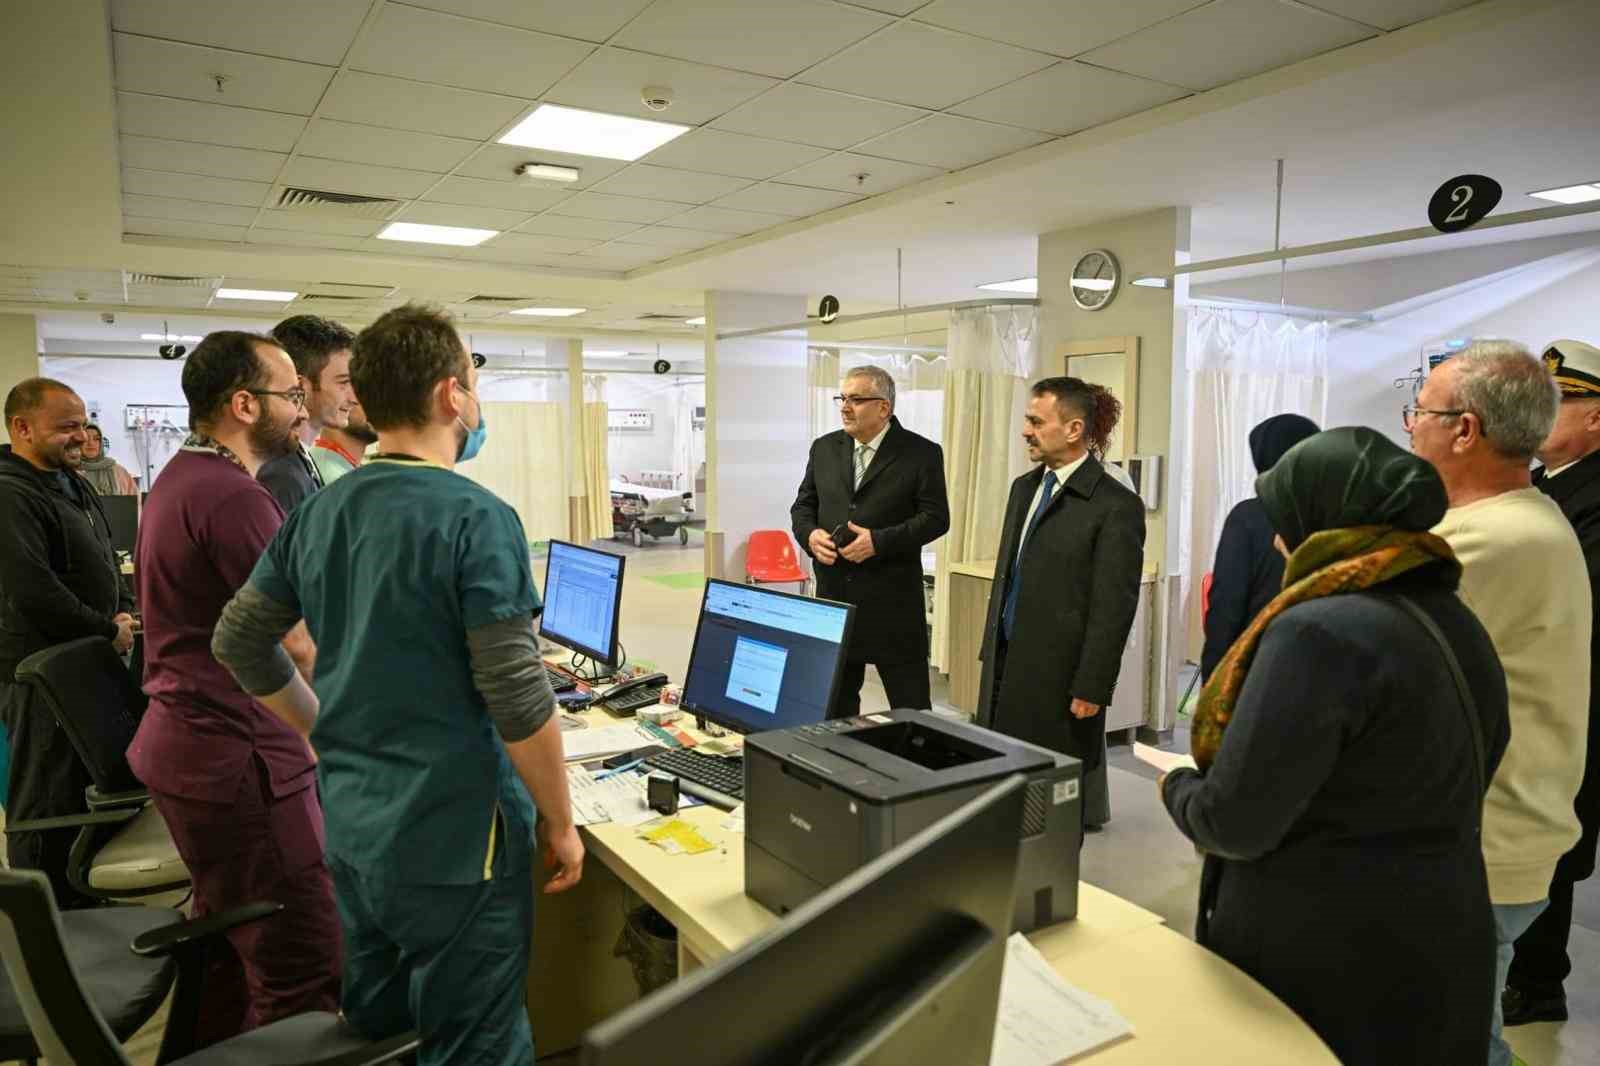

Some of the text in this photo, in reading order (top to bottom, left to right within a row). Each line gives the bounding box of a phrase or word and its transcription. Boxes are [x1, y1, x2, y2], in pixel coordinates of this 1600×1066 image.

[1444, 185, 1474, 224] 2
[166, 344, 177, 357] 4
[658, 362, 666, 372] 6
